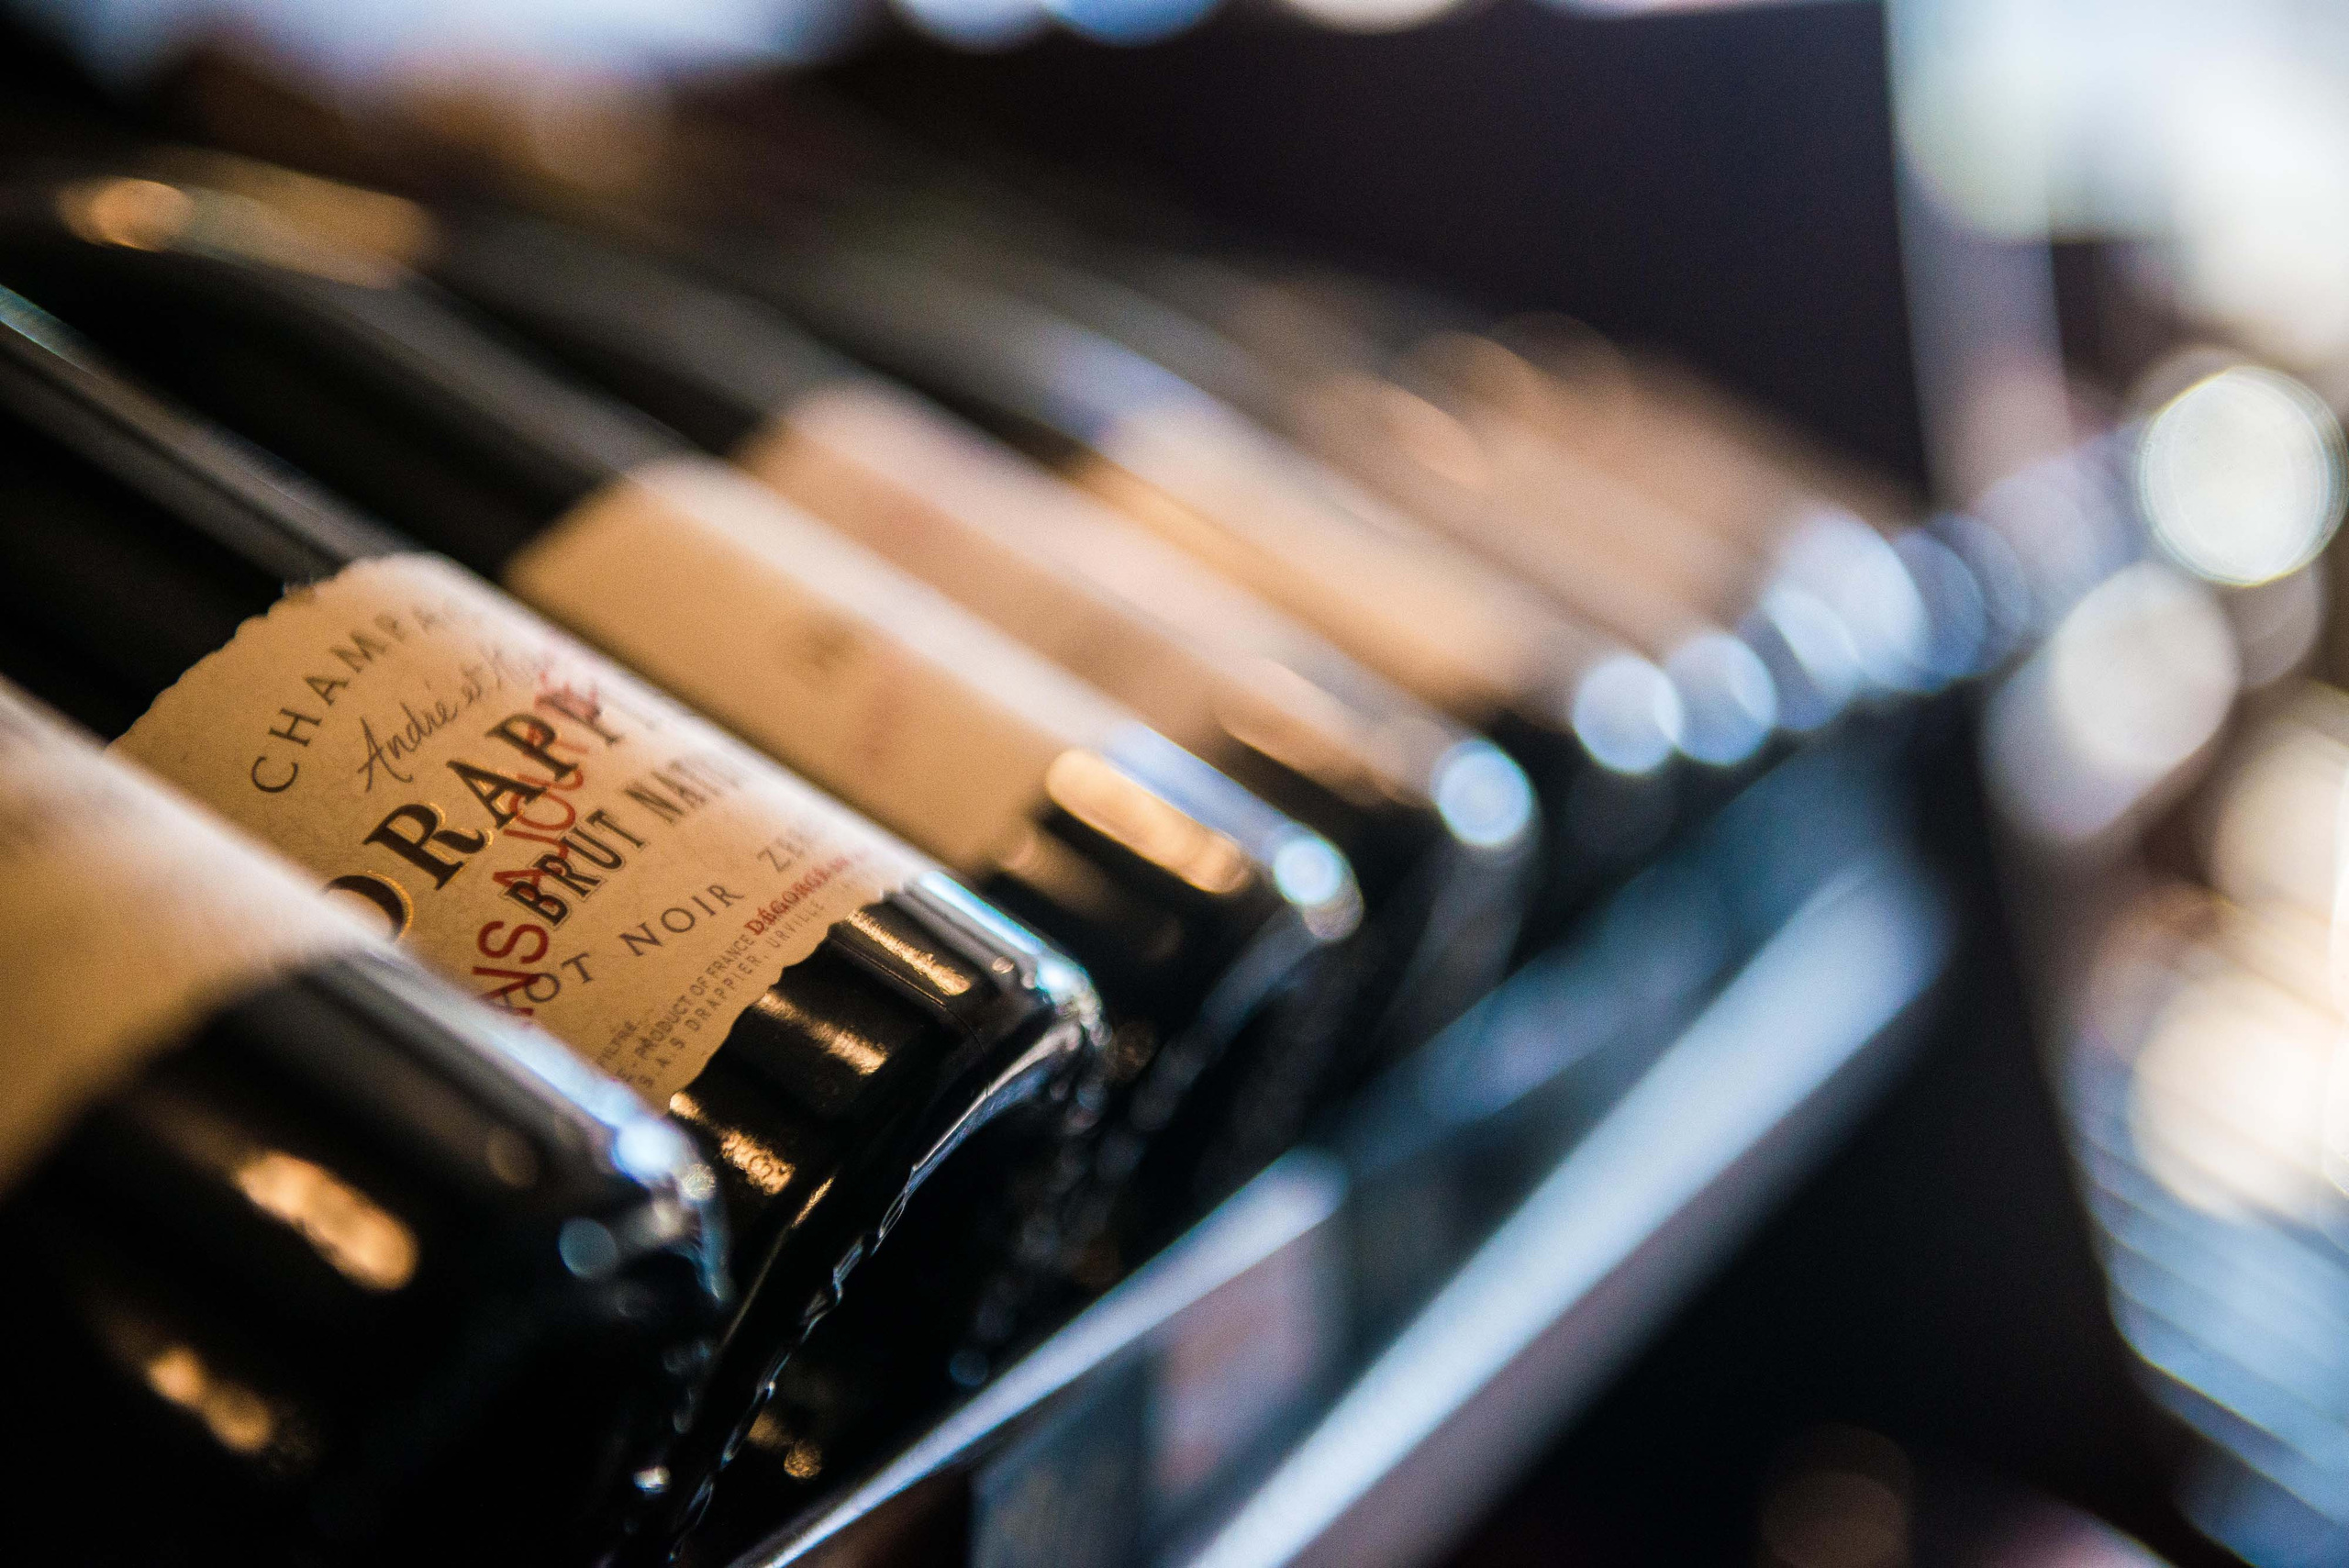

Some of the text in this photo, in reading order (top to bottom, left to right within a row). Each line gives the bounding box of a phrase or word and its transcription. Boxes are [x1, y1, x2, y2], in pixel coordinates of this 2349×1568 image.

[321, 689, 626, 943] DRAPP
[501, 810, 644, 929] BRUT
[618, 884, 744, 957] NOIR
[689, 975, 707, 996] OF
[705, 933, 754, 978] FRANCE
